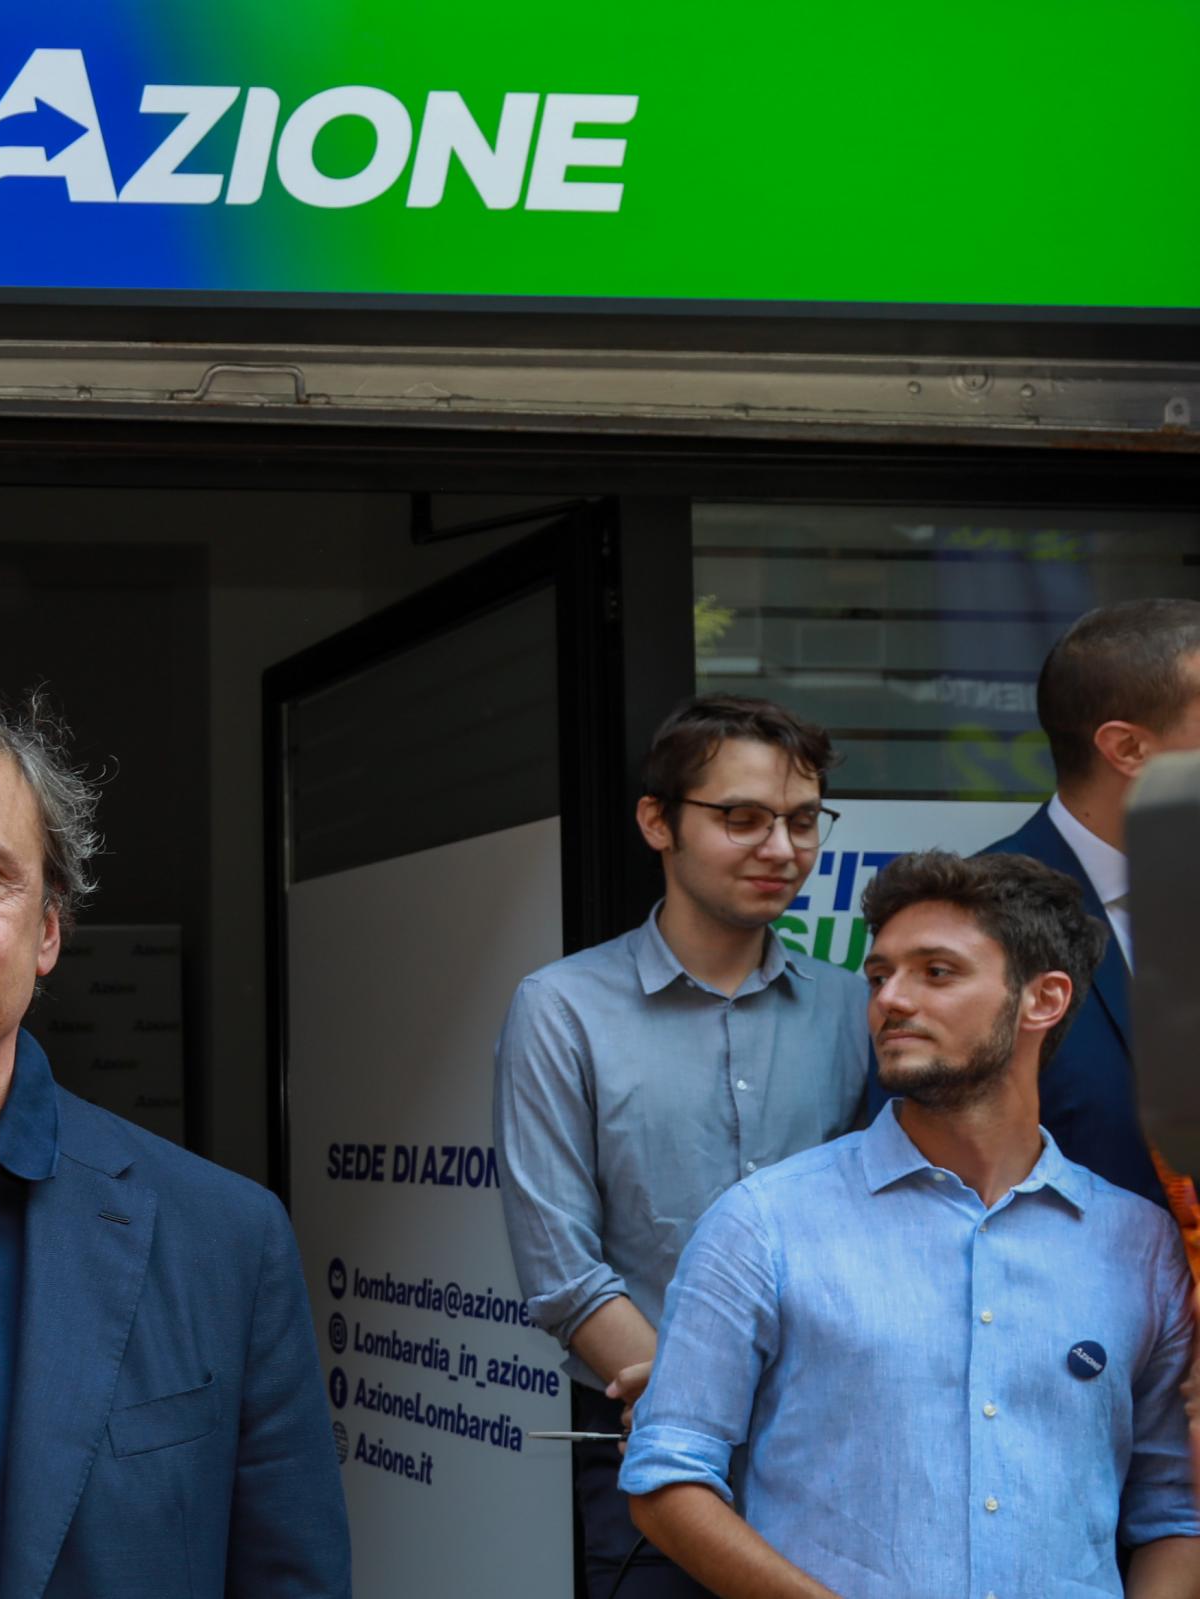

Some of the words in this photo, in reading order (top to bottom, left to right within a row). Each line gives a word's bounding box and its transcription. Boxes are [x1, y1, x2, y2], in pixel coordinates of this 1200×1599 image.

[327, 1143, 386, 1182] SEDE
[392, 1145, 418, 1184] DI
[353, 1322, 560, 1398] Lombardia_in_azione
[353, 1377, 523, 1453] AzioneLombardia
[354, 1432, 434, 1486] Azione.it
